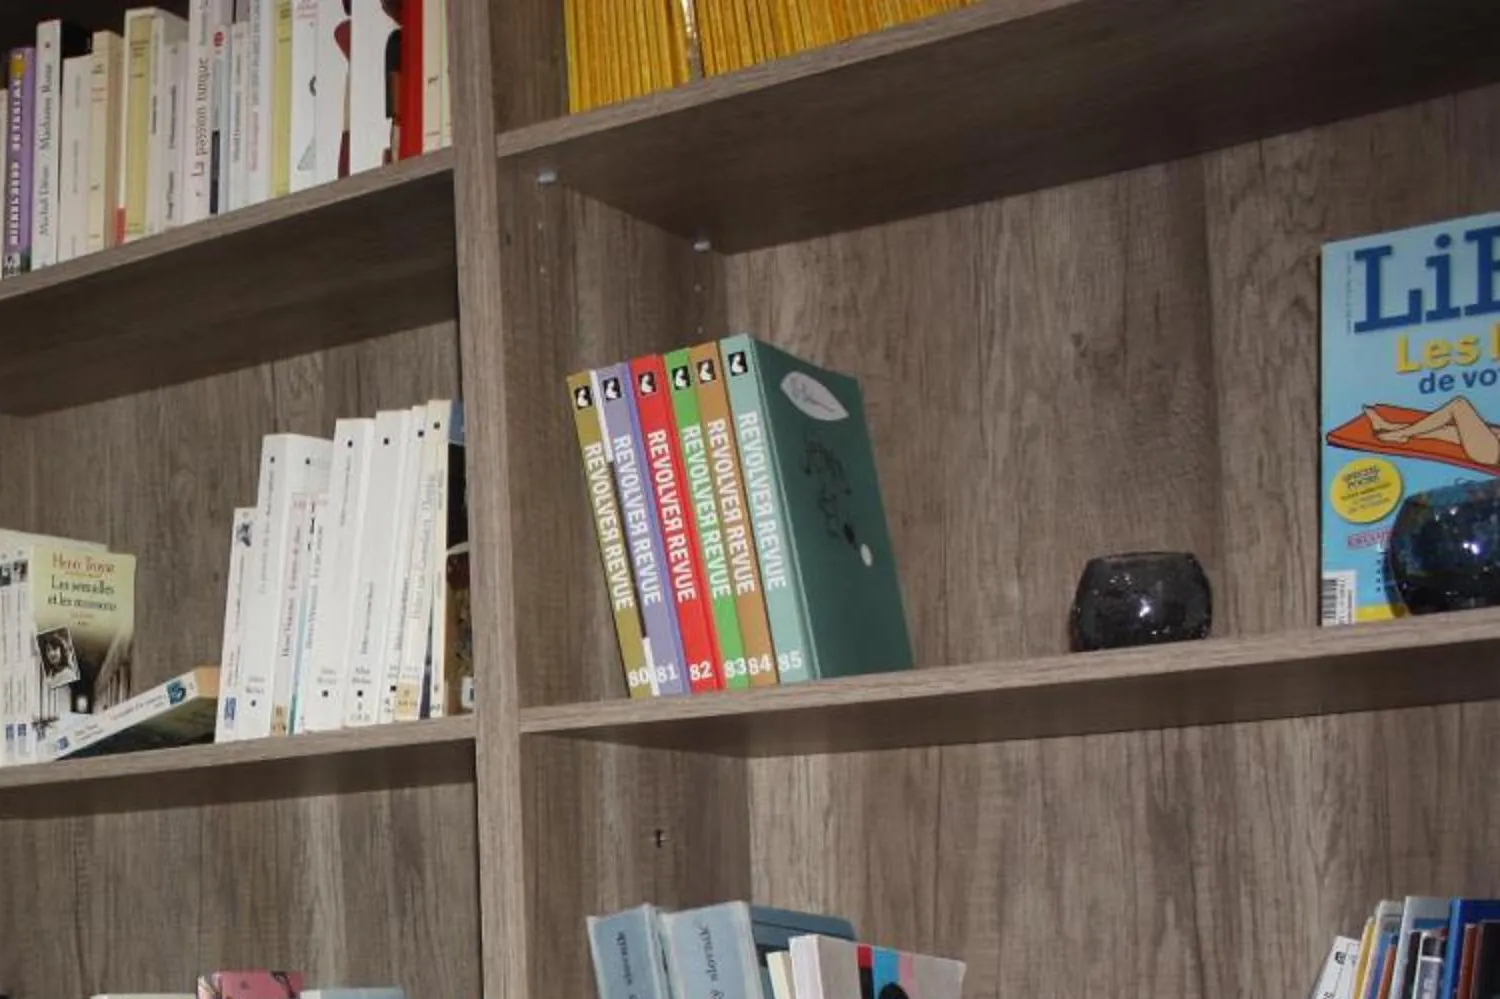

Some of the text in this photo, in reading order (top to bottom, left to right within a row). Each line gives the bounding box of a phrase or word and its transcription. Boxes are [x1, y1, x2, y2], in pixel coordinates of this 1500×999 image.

[193, 105, 210, 157] passion
[191, 161, 204, 176] La
[1395, 331, 1482, 375] Les
[1418, 366, 1500, 395] de vo
[632, 538, 662, 607] REVUE
[666, 535, 697, 603] REVUE
[701, 530, 731, 598] REVUE
[726, 526, 756, 593] REVUE
[756, 521, 787, 590] REVUE
[601, 543, 634, 611] REVUE
[628, 666, 649, 686] 80
[656, 664, 678, 683] 81
[689, 661, 713, 681] 82
[724, 658, 747, 677] 83
[747, 656, 772, 675] 84
[777, 650, 803, 671] 85
